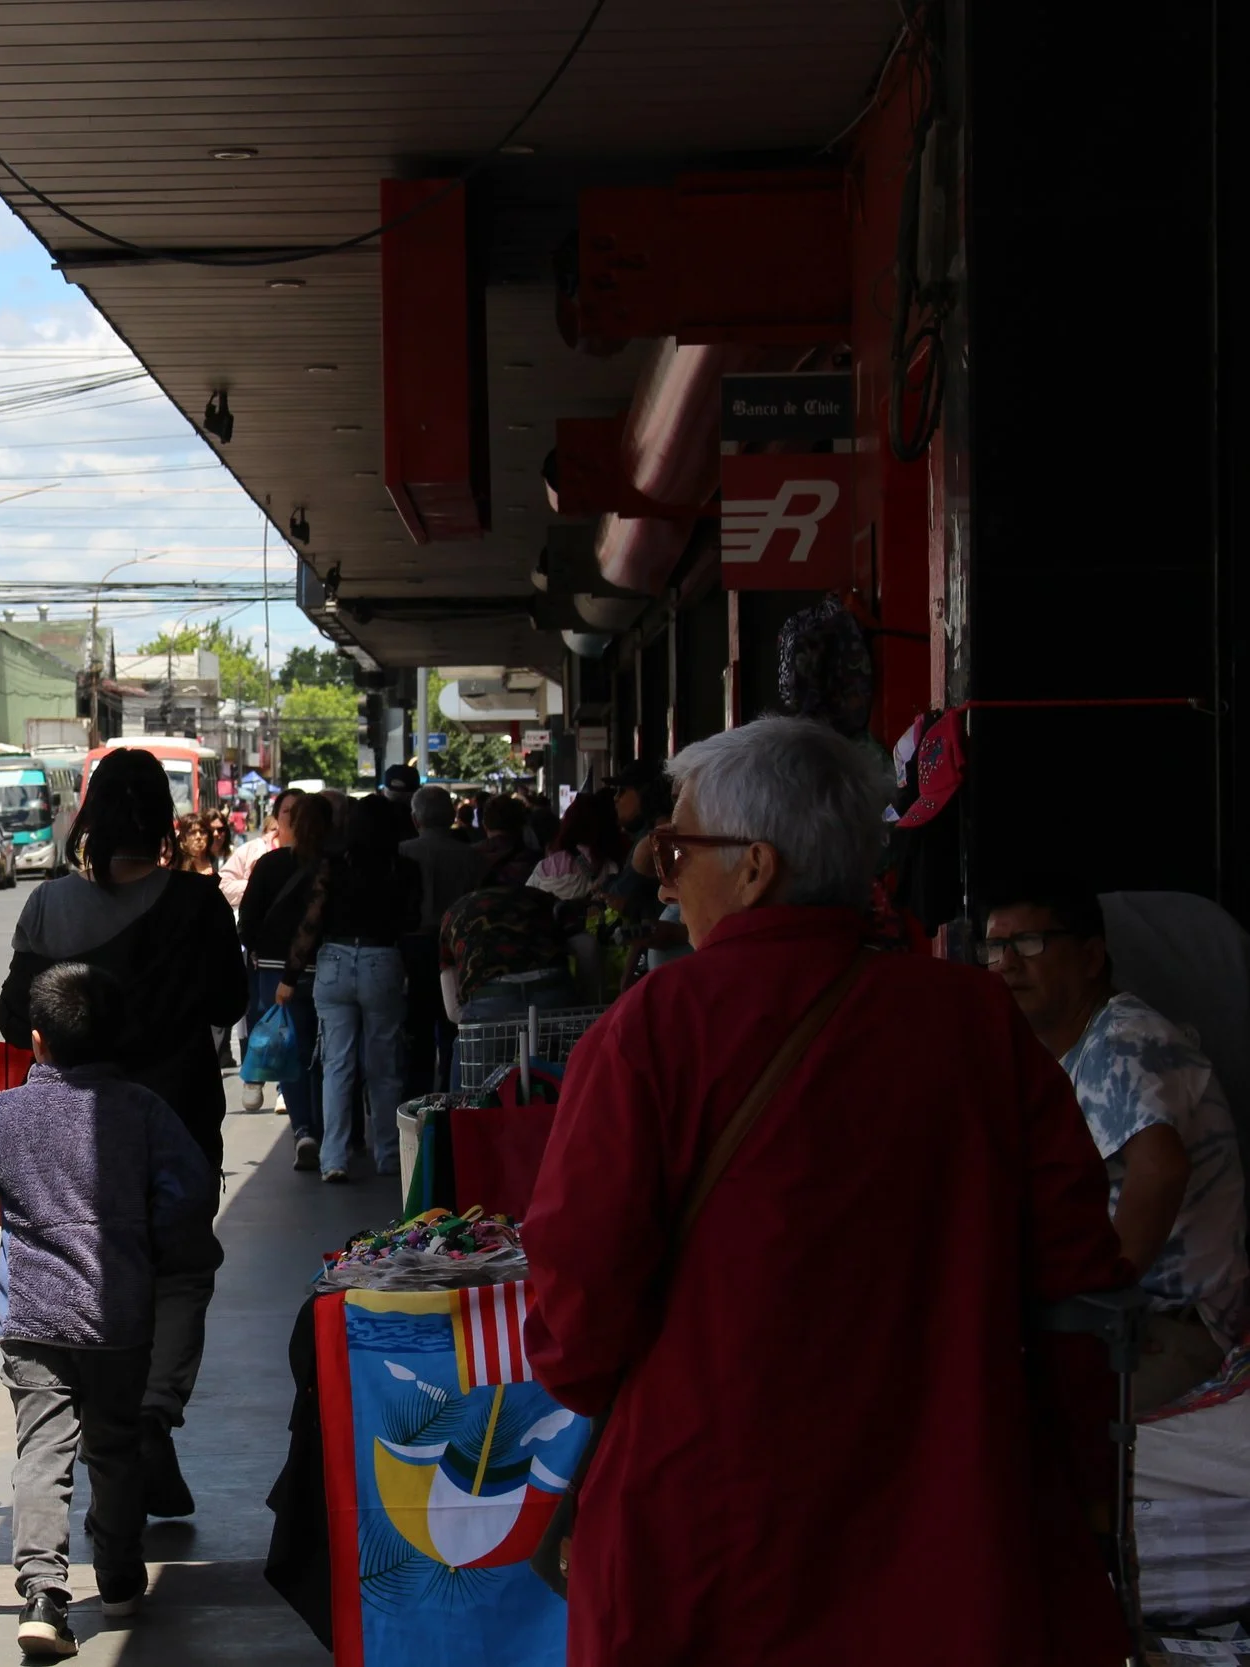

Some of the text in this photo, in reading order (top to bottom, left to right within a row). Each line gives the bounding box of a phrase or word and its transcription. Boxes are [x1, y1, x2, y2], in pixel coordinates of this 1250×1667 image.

[732, 399, 841, 416] Banco de Chile
